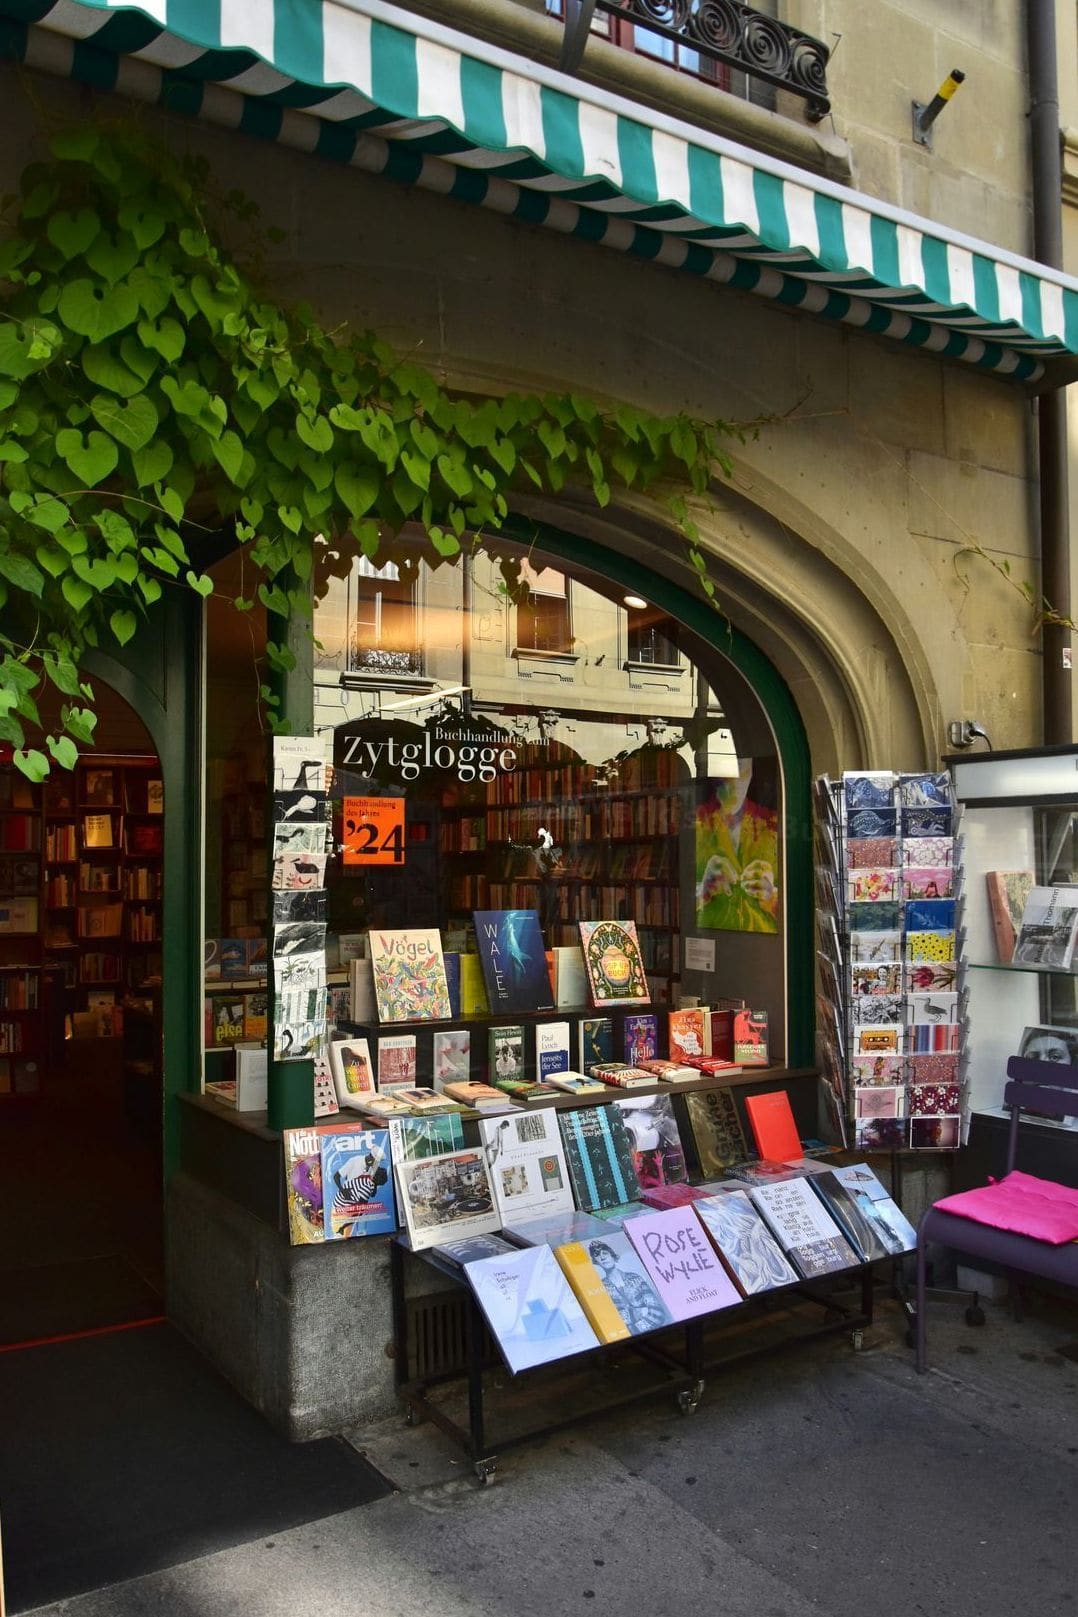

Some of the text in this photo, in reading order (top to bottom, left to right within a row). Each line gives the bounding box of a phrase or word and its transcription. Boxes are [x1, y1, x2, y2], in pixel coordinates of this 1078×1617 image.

[435, 727, 523, 748] Buchhandlung
[343, 731, 517, 783] Zytglogge
[380, 934, 434, 961] Vögel
[484, 924, 506, 990] WALE
[630, 1045, 655, 1060] Hello
[335, 1131, 376, 1151] art
[642, 1228, 701, 1264] ROSE
[655, 1248, 715, 1283] WYLIE
